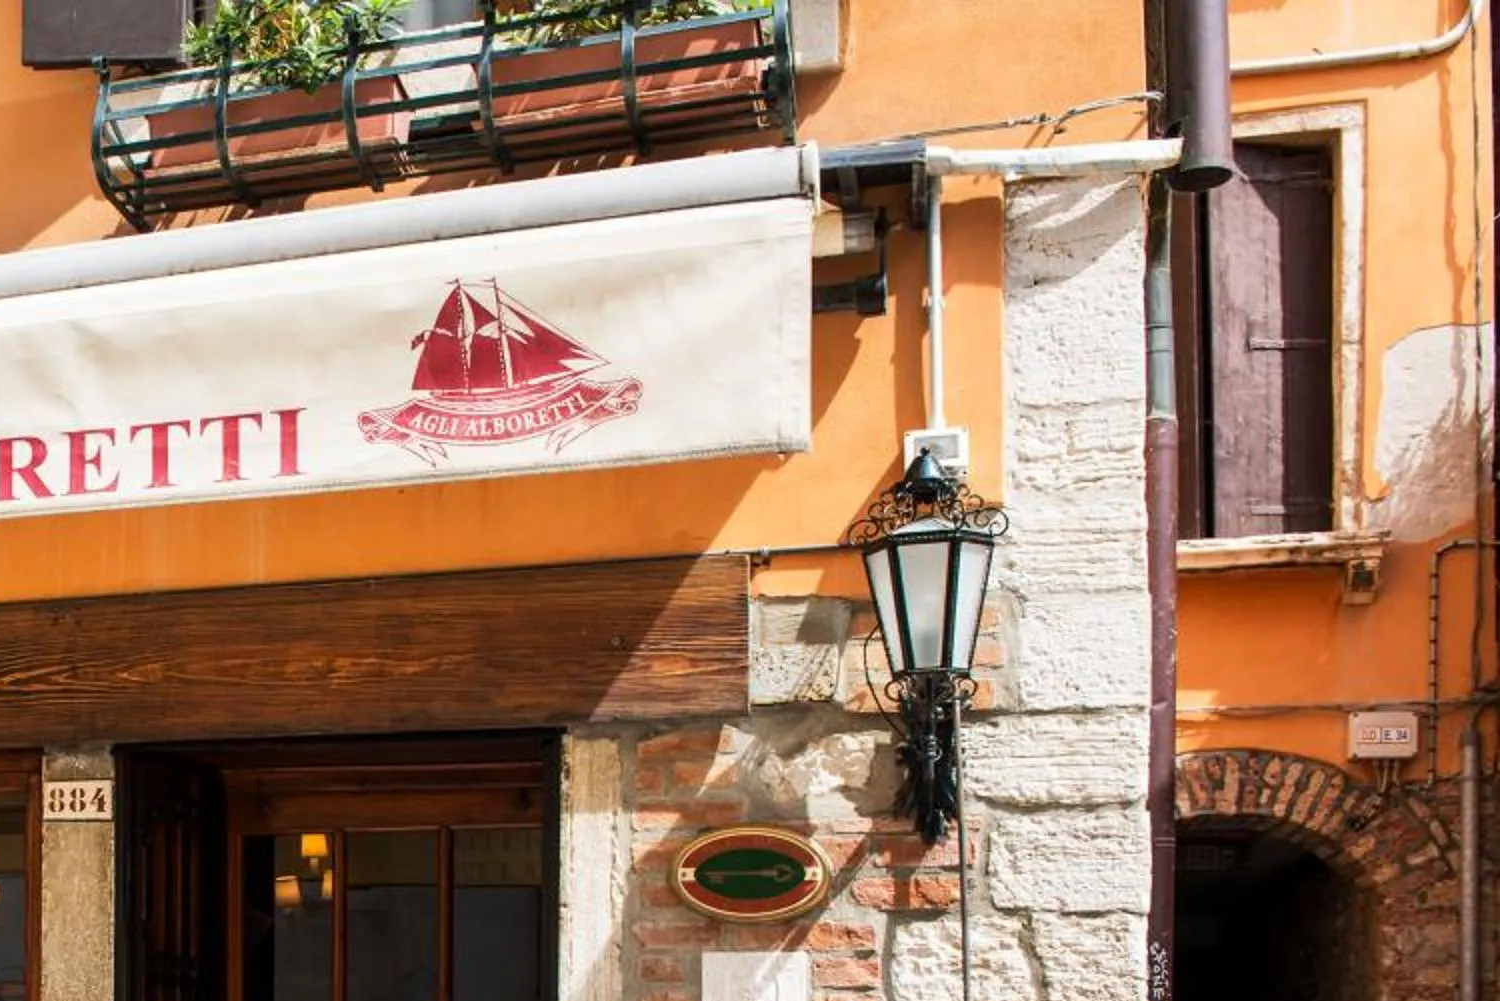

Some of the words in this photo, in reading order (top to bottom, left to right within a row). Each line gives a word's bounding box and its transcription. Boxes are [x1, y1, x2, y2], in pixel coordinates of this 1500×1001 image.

[411, 411, 459, 437] AGLI
[464, 392, 587, 438] ALBORETTI
[49, 787, 107, 813] 884
